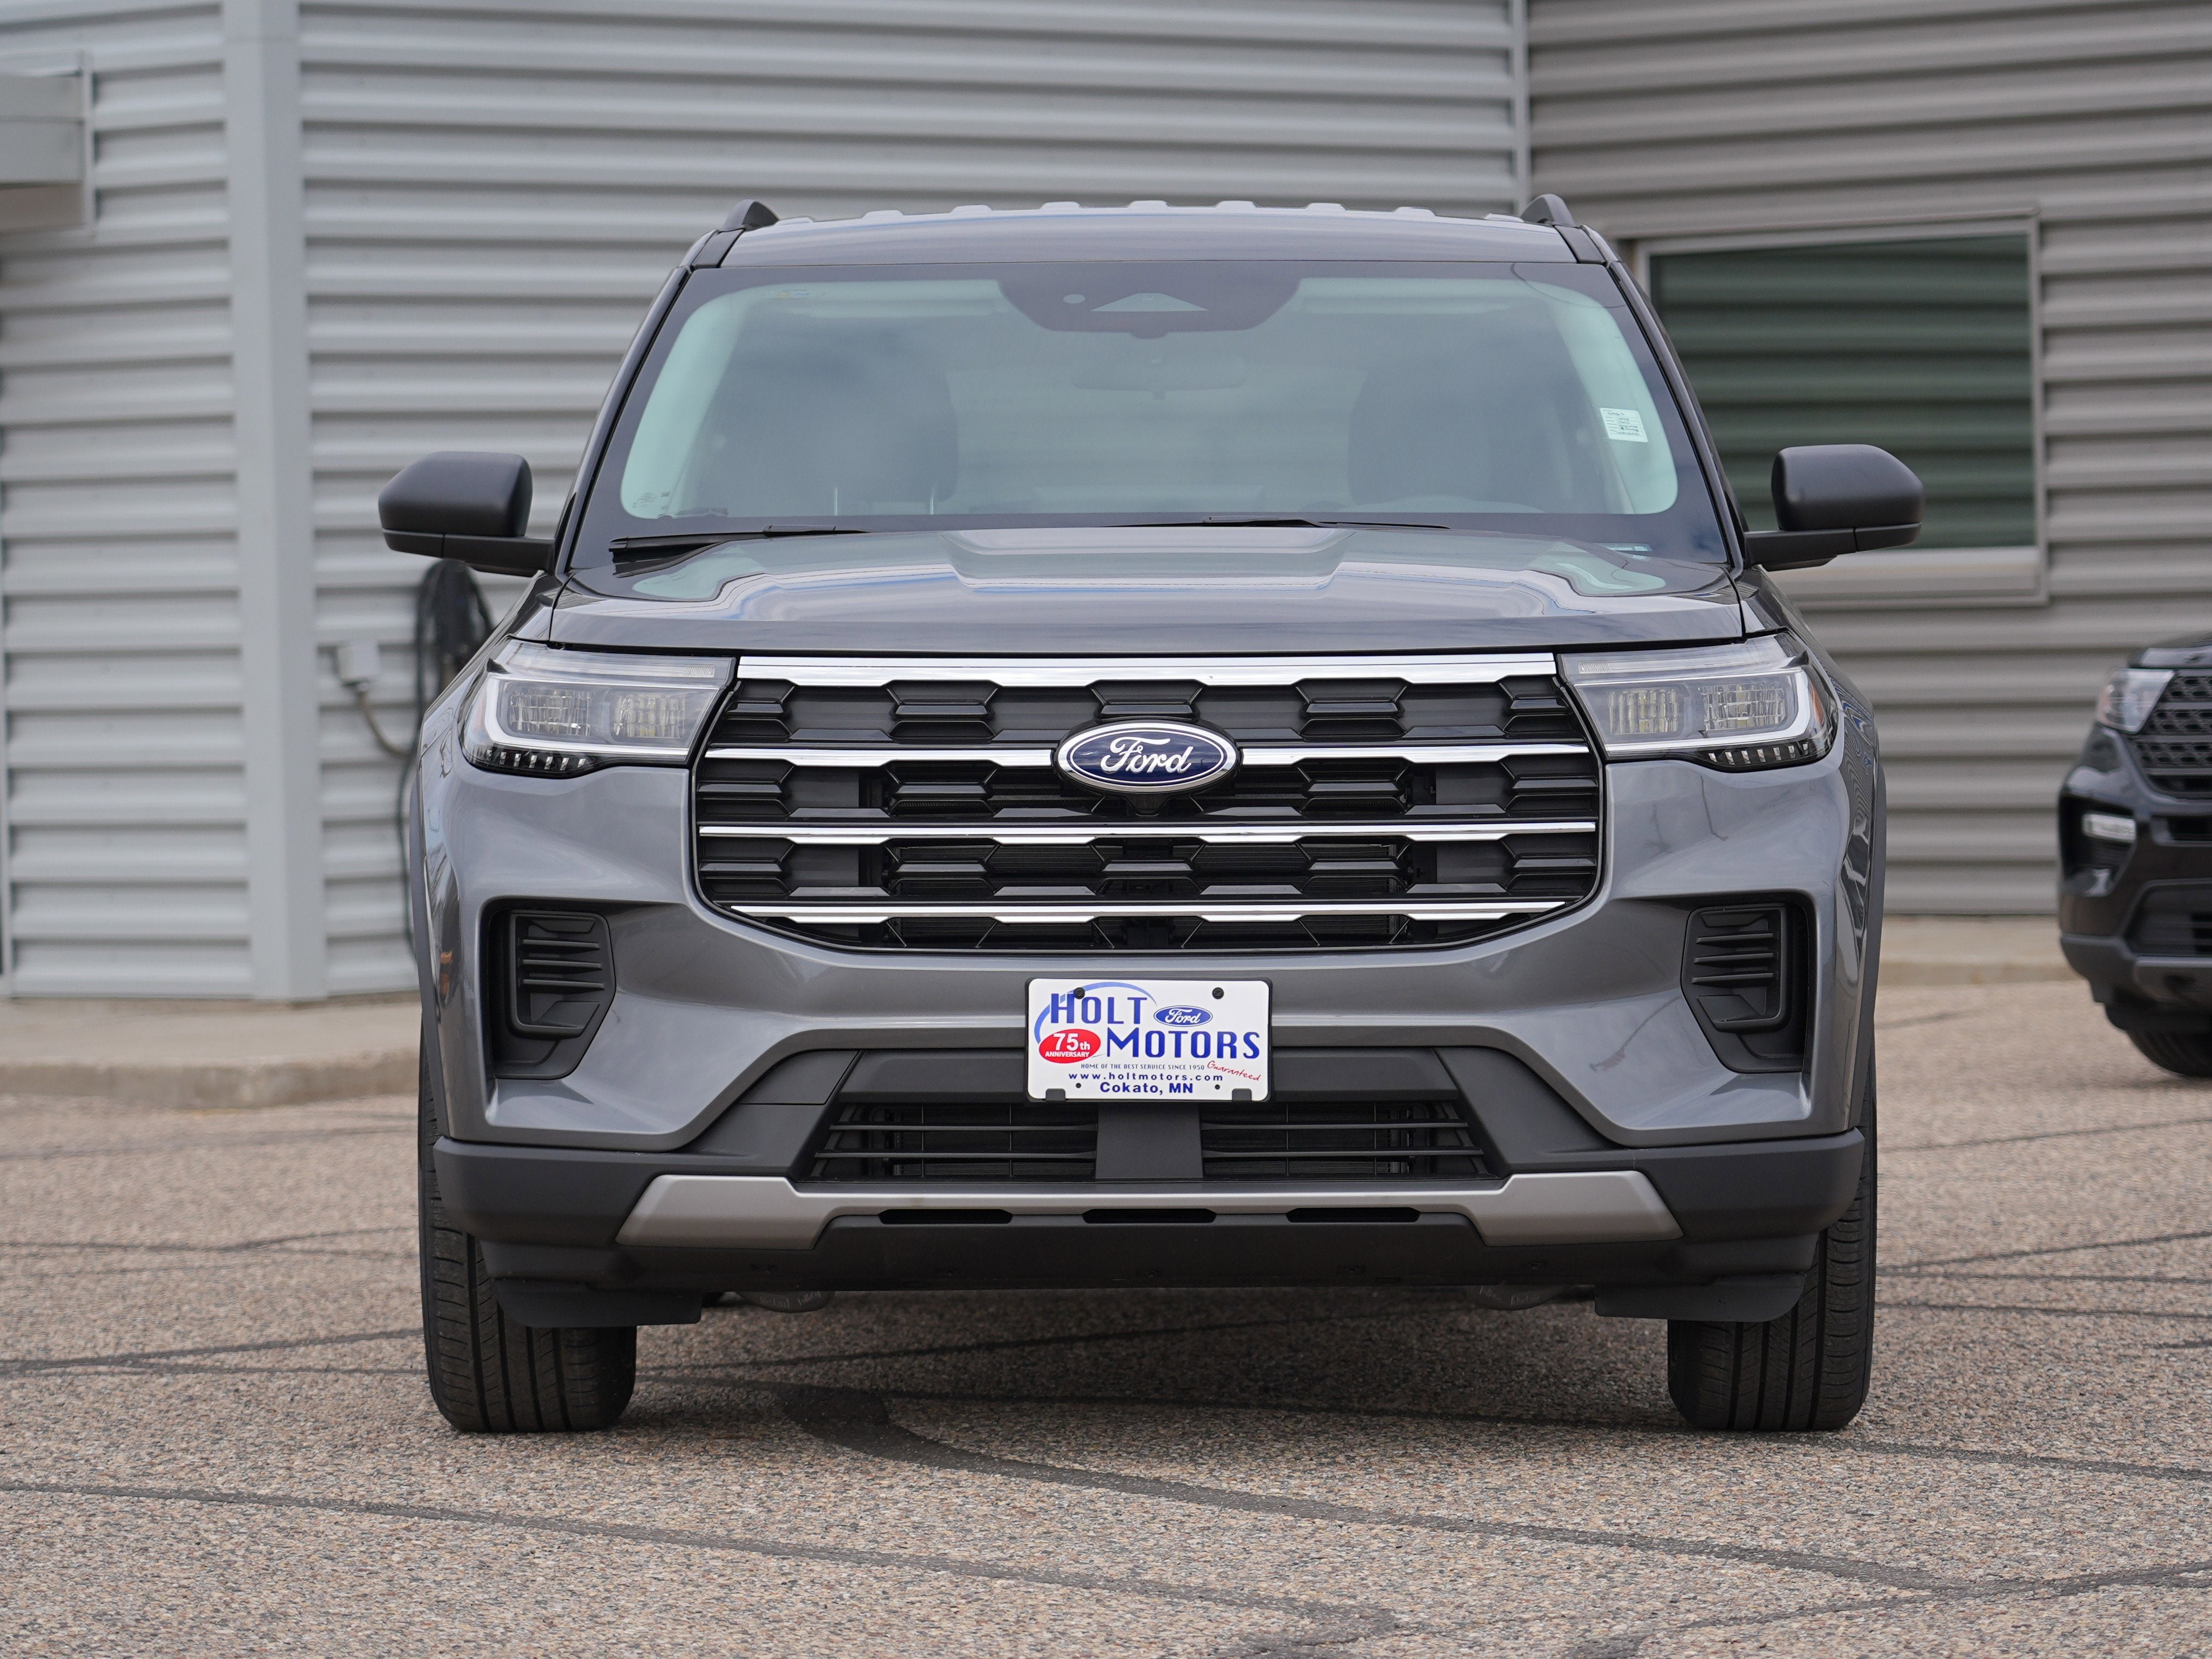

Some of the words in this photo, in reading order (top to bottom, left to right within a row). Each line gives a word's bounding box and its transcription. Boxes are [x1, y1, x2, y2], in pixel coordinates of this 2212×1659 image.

[1101, 736, 1194, 773] Ford
[1050, 993, 1148, 1024] HOLT
[1165, 1008, 1202, 1024] Ford
[1053, 1033, 1091, 1051] 75th
[1107, 1027, 1260, 1059] MOTORS
[1068, 1072, 1223, 1081] www.holtmotors.com
[1207, 1060, 1262, 1082] Guaranteed
[1100, 1082, 1163, 1095] Cokato,
[1169, 1083, 1193, 1094] MN
